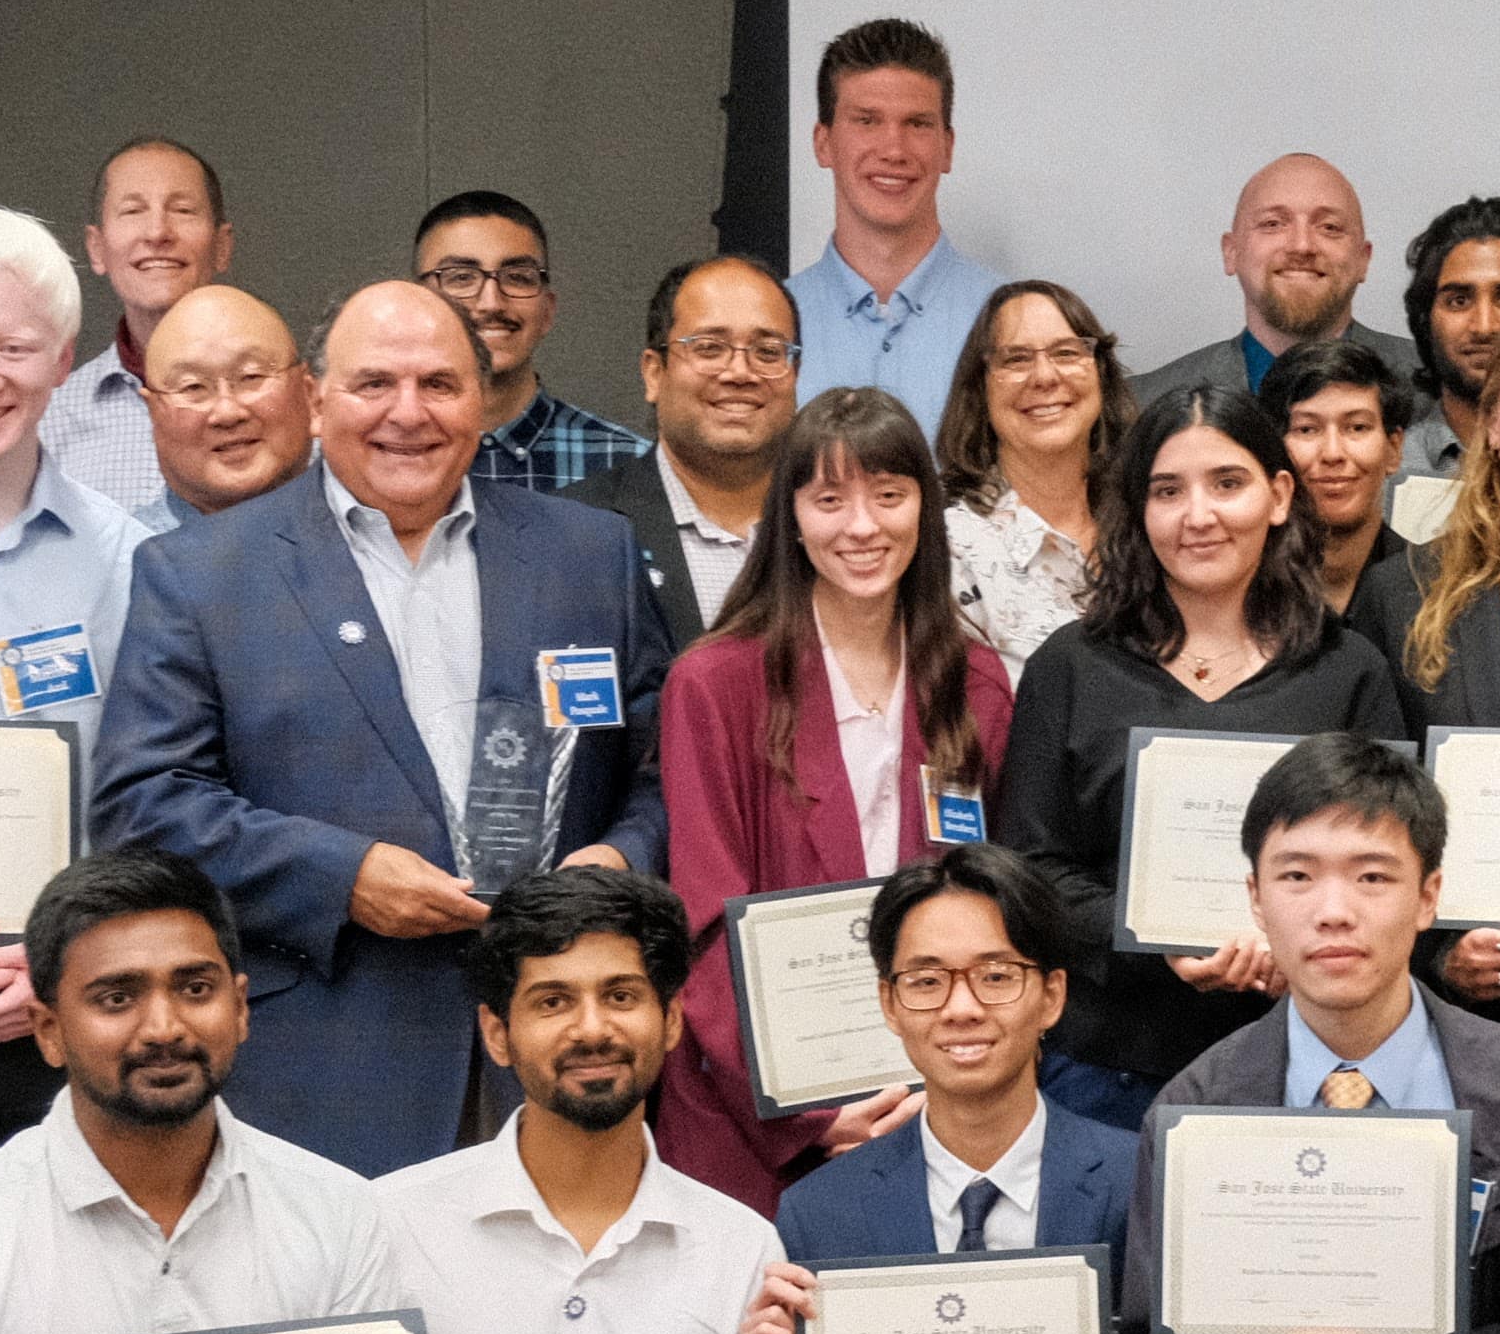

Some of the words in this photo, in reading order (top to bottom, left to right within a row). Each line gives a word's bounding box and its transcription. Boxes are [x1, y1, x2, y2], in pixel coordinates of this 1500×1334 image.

[1217, 1180, 1247, 1194] San
[1289, 1181, 1327, 1195] State
[1332, 1181, 1404, 1196] University
